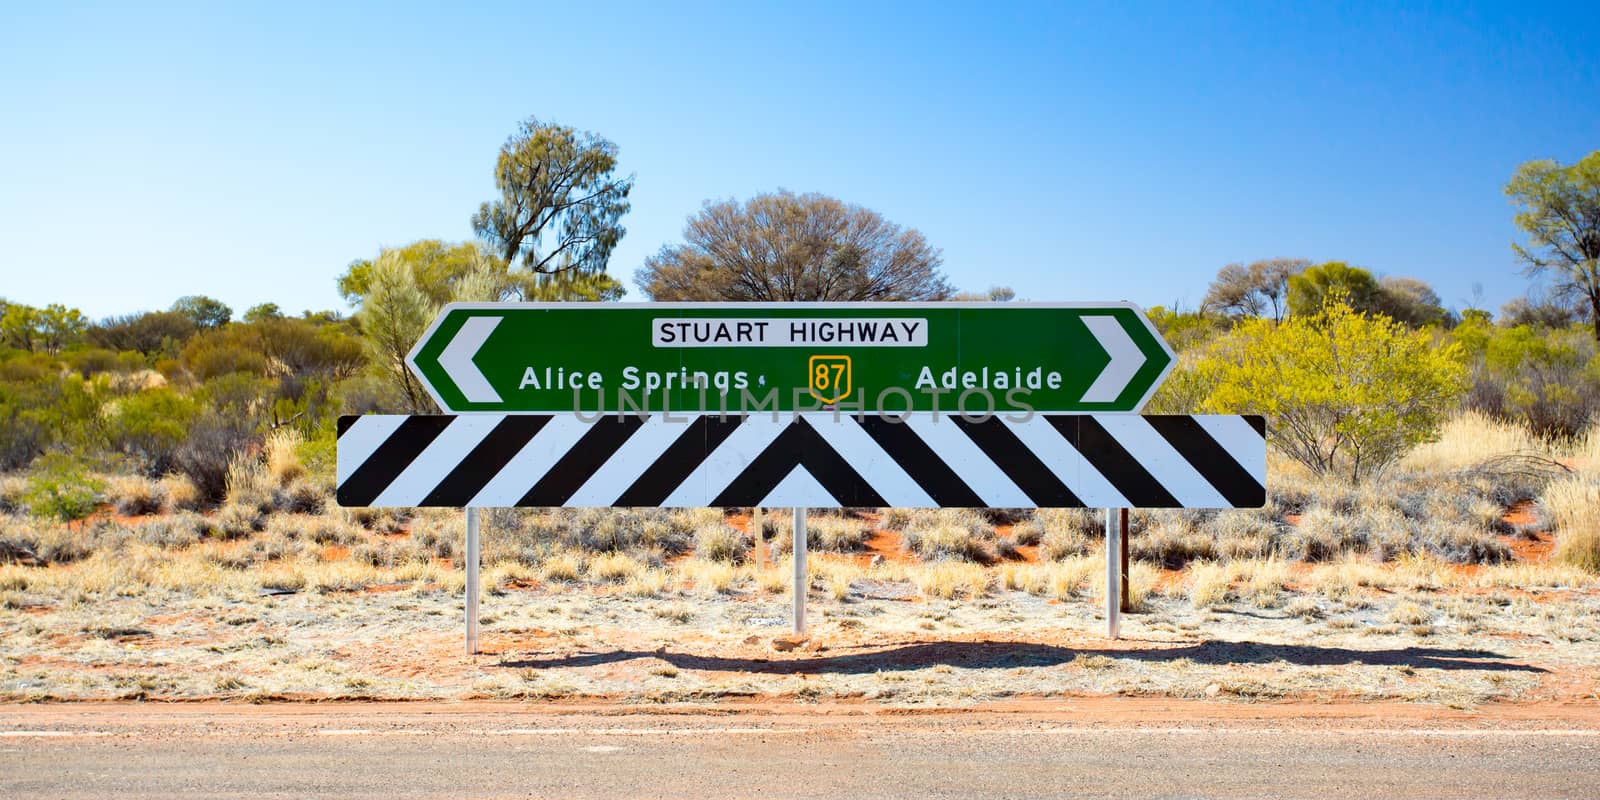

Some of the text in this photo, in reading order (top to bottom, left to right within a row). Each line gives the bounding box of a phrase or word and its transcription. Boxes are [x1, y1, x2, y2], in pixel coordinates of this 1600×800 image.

[660, 322, 920, 342] STUART HIGHWAY
[519, 366, 749, 394] Alice Springs
[815, 364, 846, 390] 87
[915, 366, 1063, 389] Adelaide
